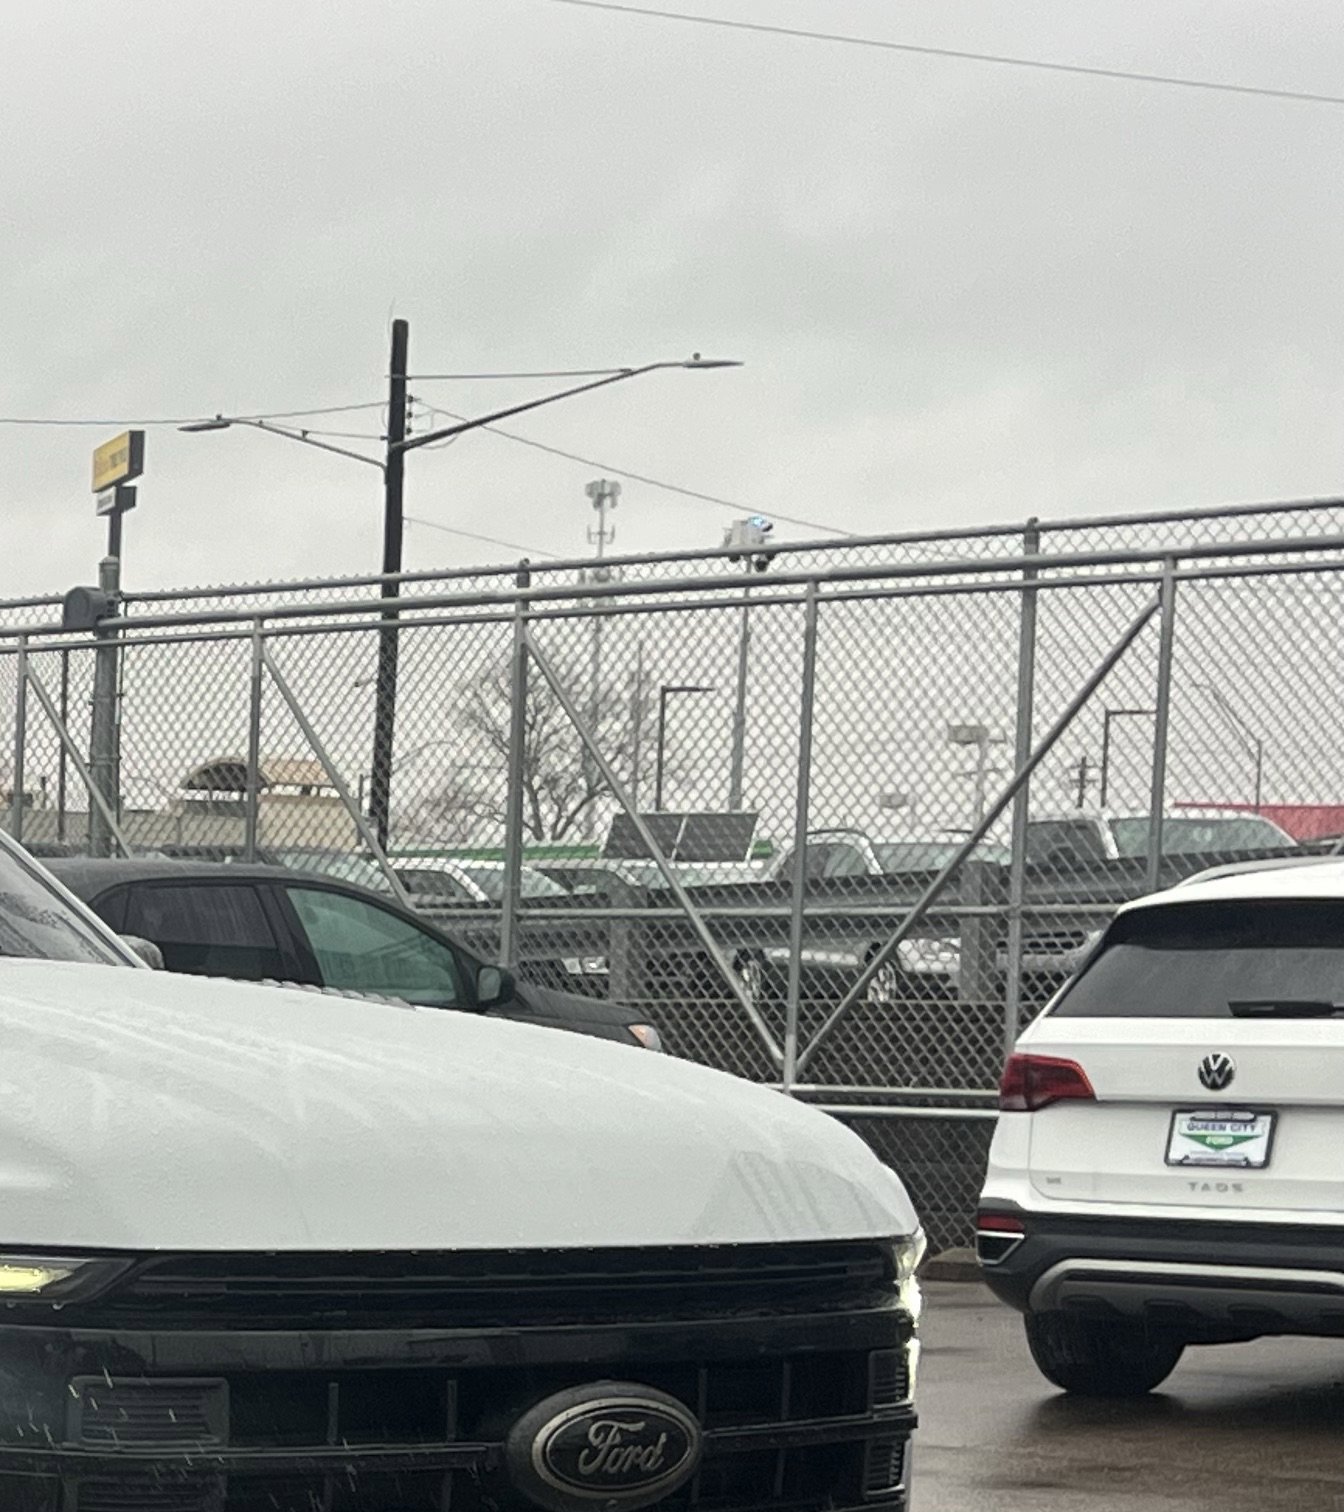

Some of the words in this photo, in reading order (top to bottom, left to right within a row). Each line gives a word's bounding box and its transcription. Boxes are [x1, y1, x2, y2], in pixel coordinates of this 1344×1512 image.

[1186, 1122, 1227, 1132] QUEEN
[1230, 1122, 1257, 1132] CITY
[1187, 1181, 1244, 1193] TAOS
[578, 1420, 667, 1476] Ford
